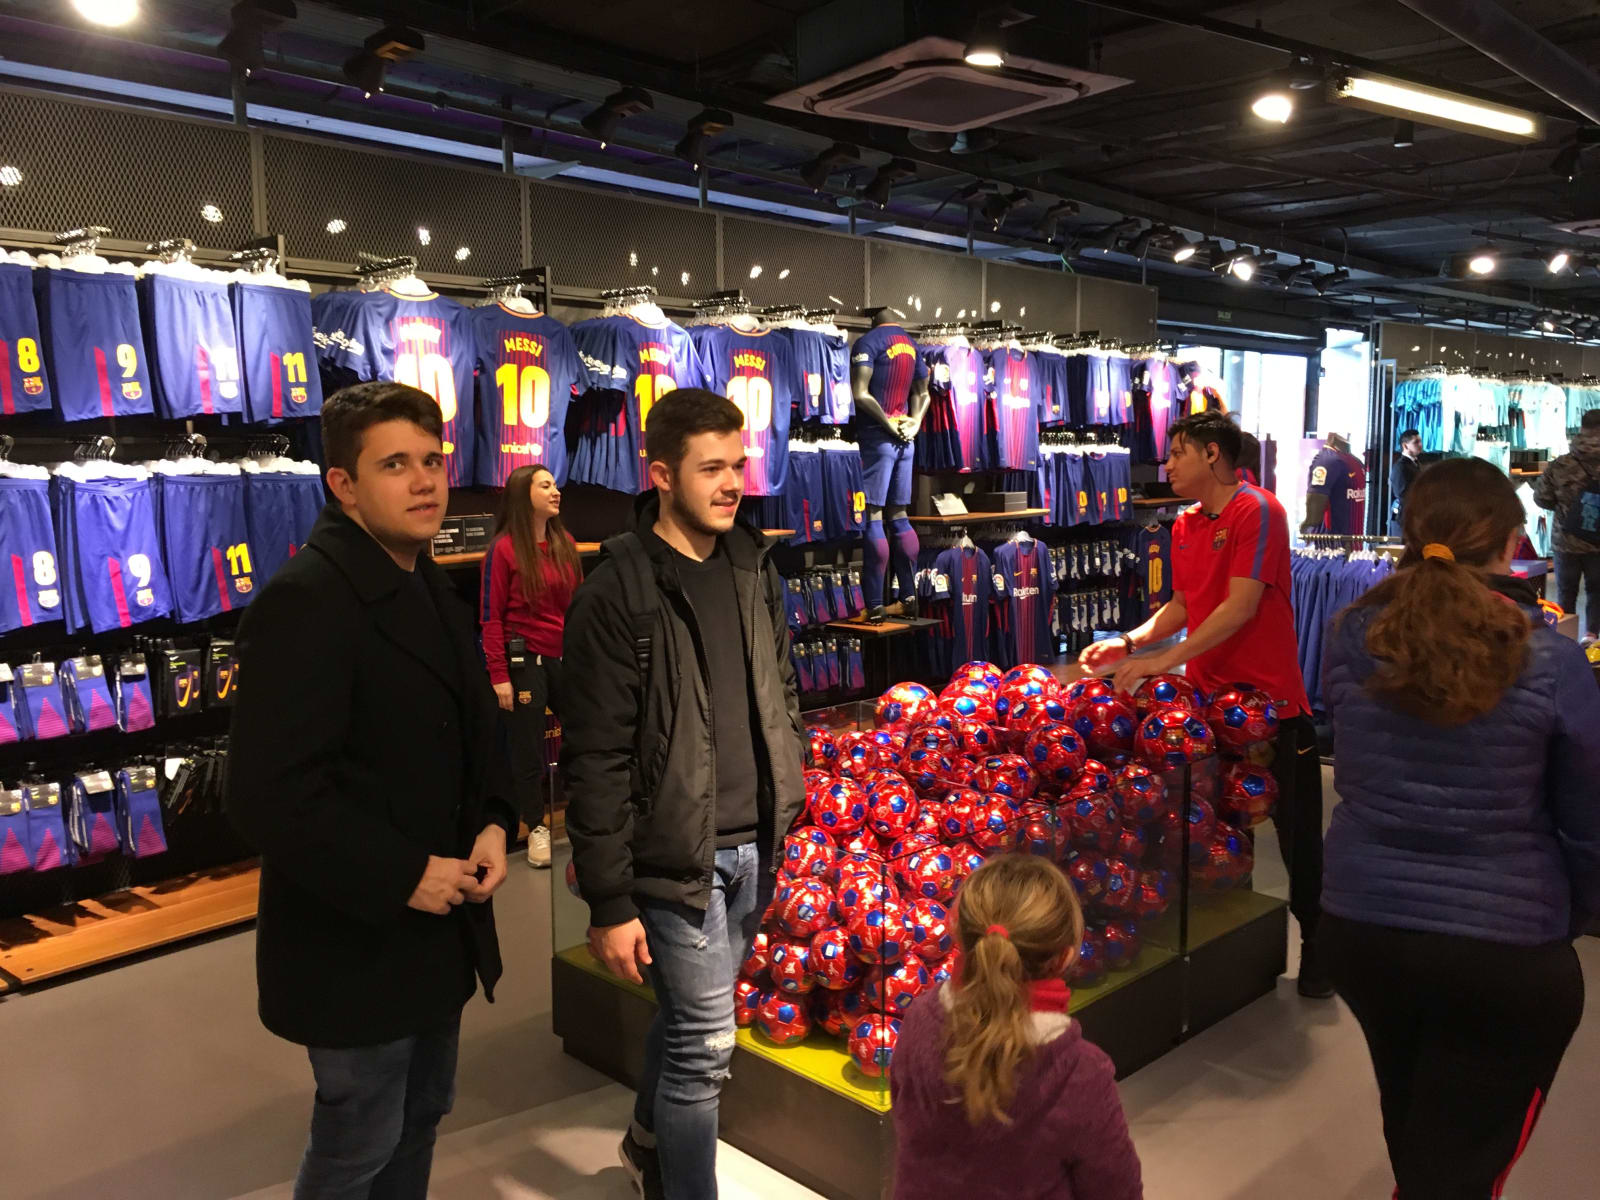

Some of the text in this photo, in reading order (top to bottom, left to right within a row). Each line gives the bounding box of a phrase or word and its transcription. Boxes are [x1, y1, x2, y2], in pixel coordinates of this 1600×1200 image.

[17, 337, 40, 373] 8
[116, 343, 137, 378] 9
[504, 337, 543, 357] MESSI
[733, 354, 766, 371] MESSI
[283, 352, 307, 382] 11
[495, 363, 551, 429] 10
[726, 375, 773, 432] 10
[32, 550, 57, 586] 8
[127, 553, 151, 588] 9
[226, 542, 253, 576] 11
